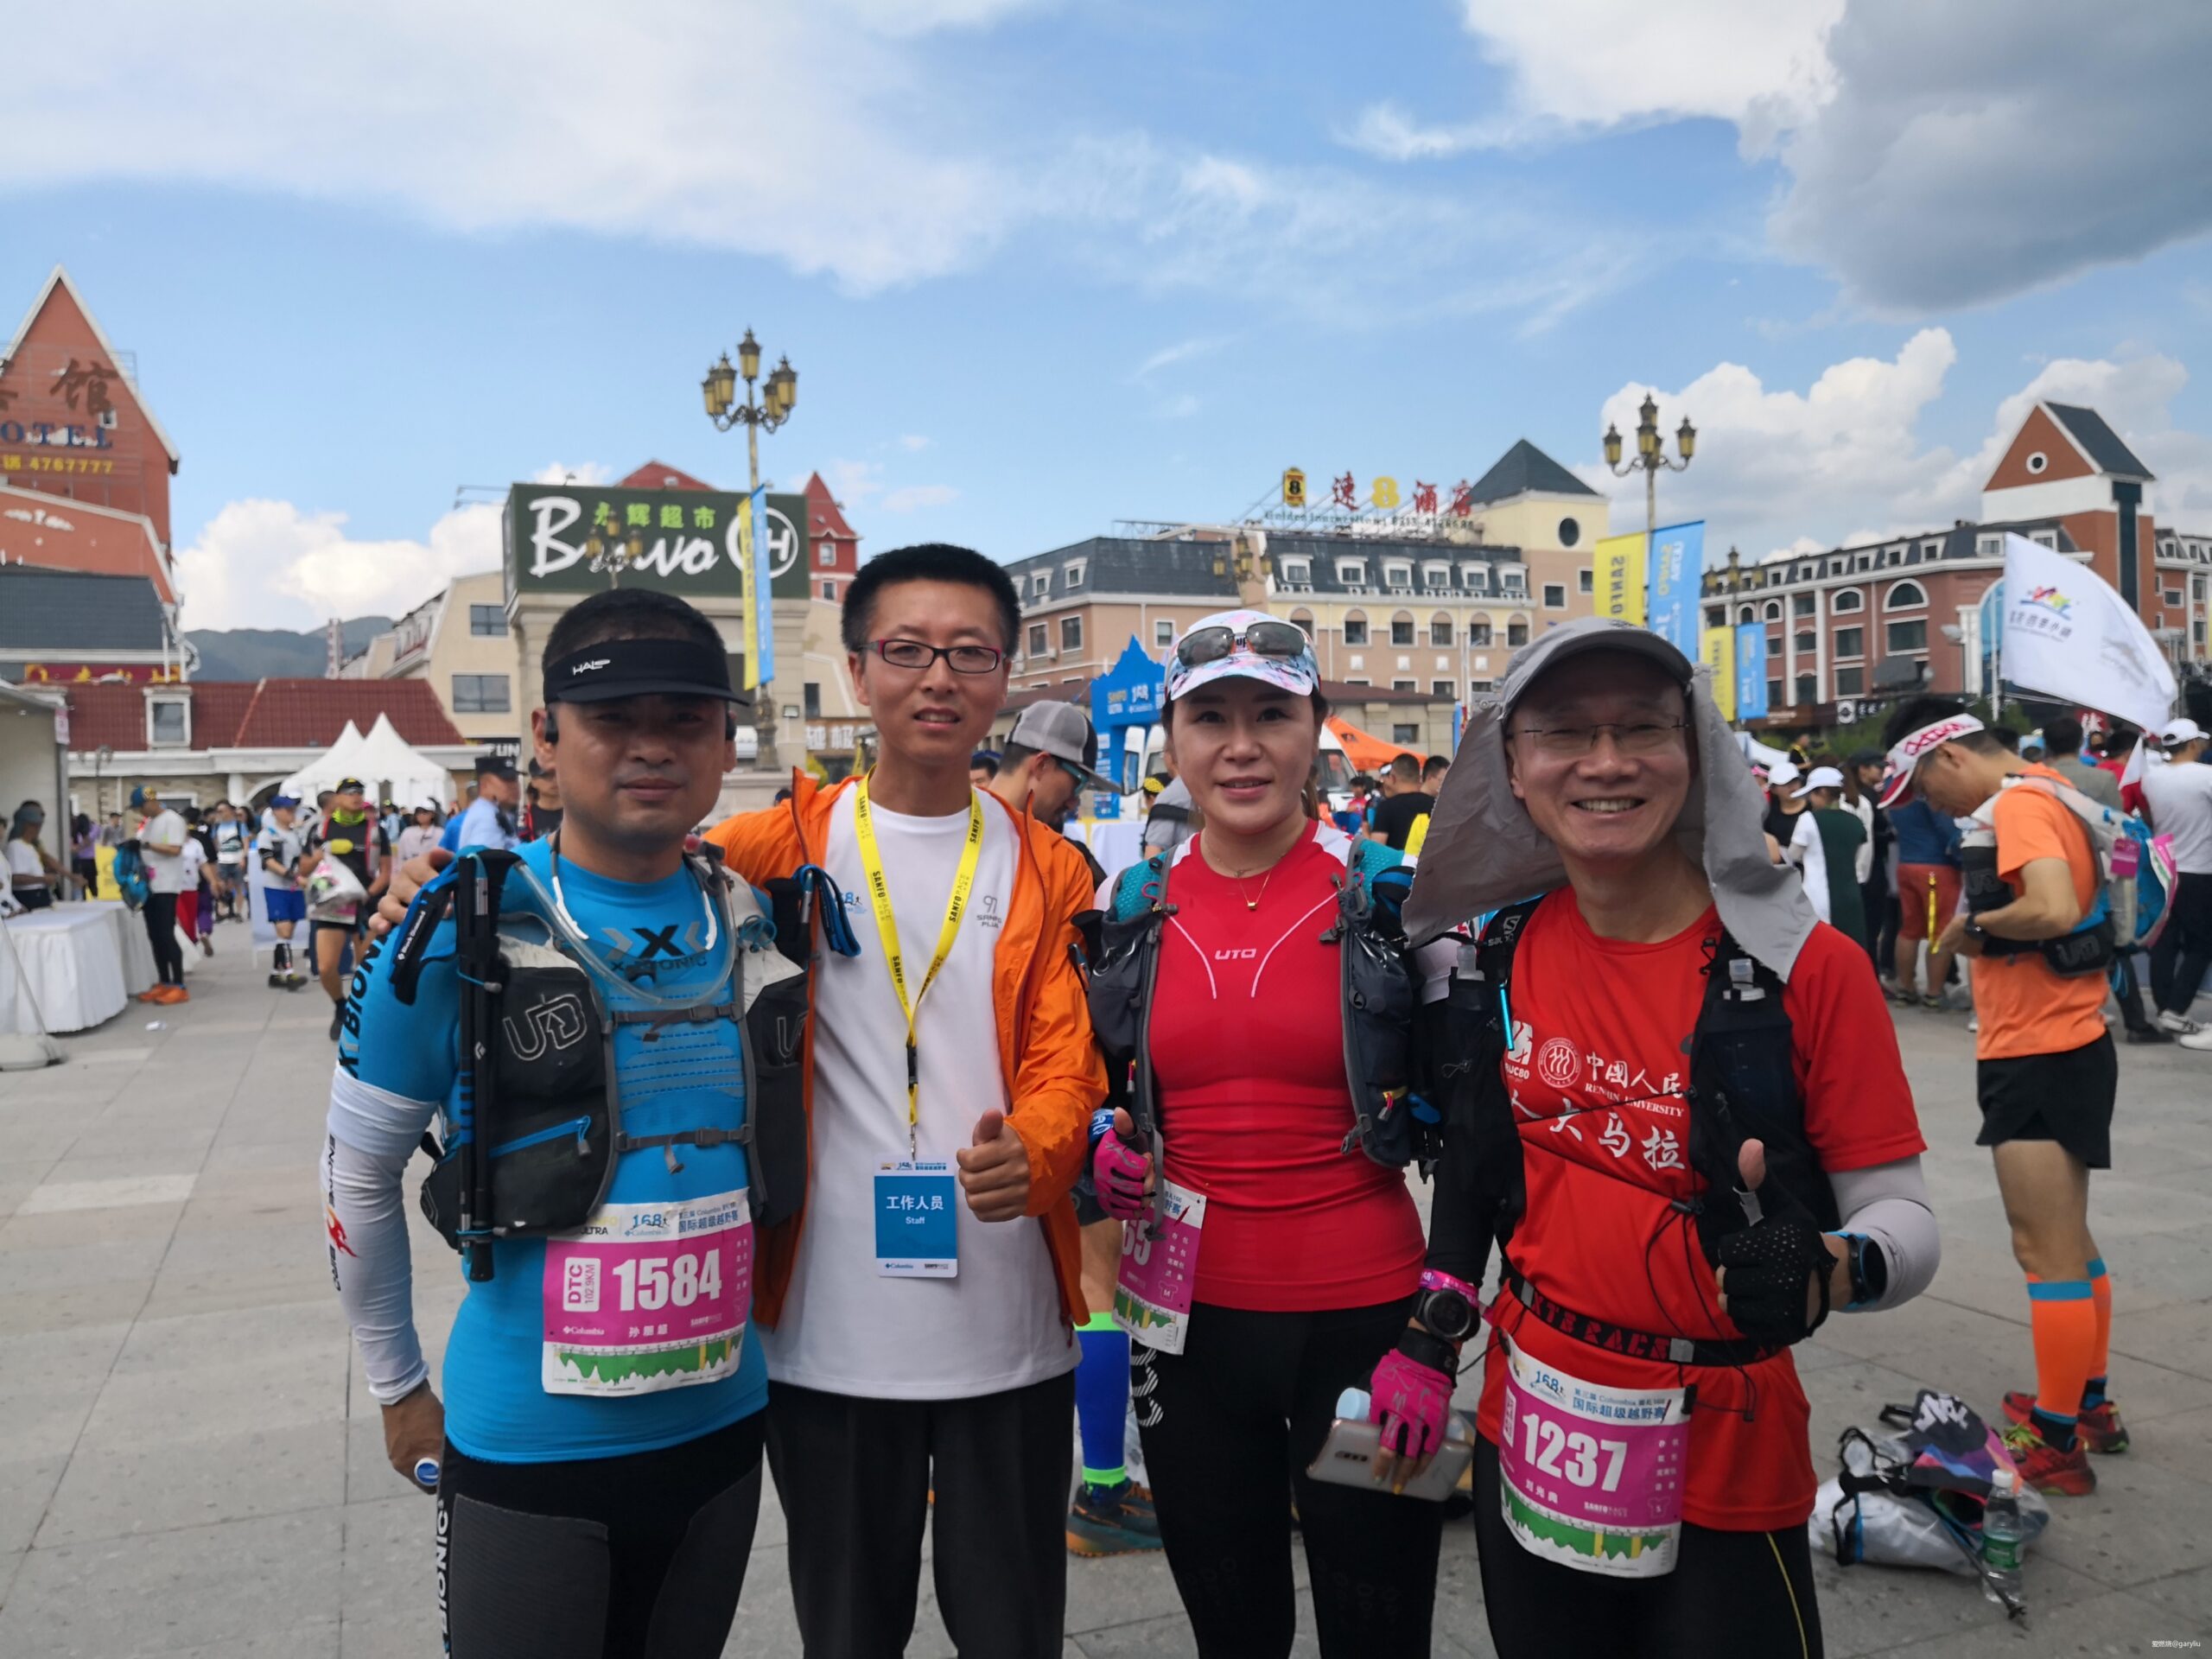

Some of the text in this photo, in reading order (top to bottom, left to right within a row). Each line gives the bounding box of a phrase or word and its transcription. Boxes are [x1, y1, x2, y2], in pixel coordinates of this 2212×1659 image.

[528, 496, 719, 577] Bvo
[886, 1195, 944, 1211] 工作人员
[568, 1264, 583, 1304] DTC
[613, 1248, 722, 1312] 1584
[1522, 1413, 1627, 1492] 1237
